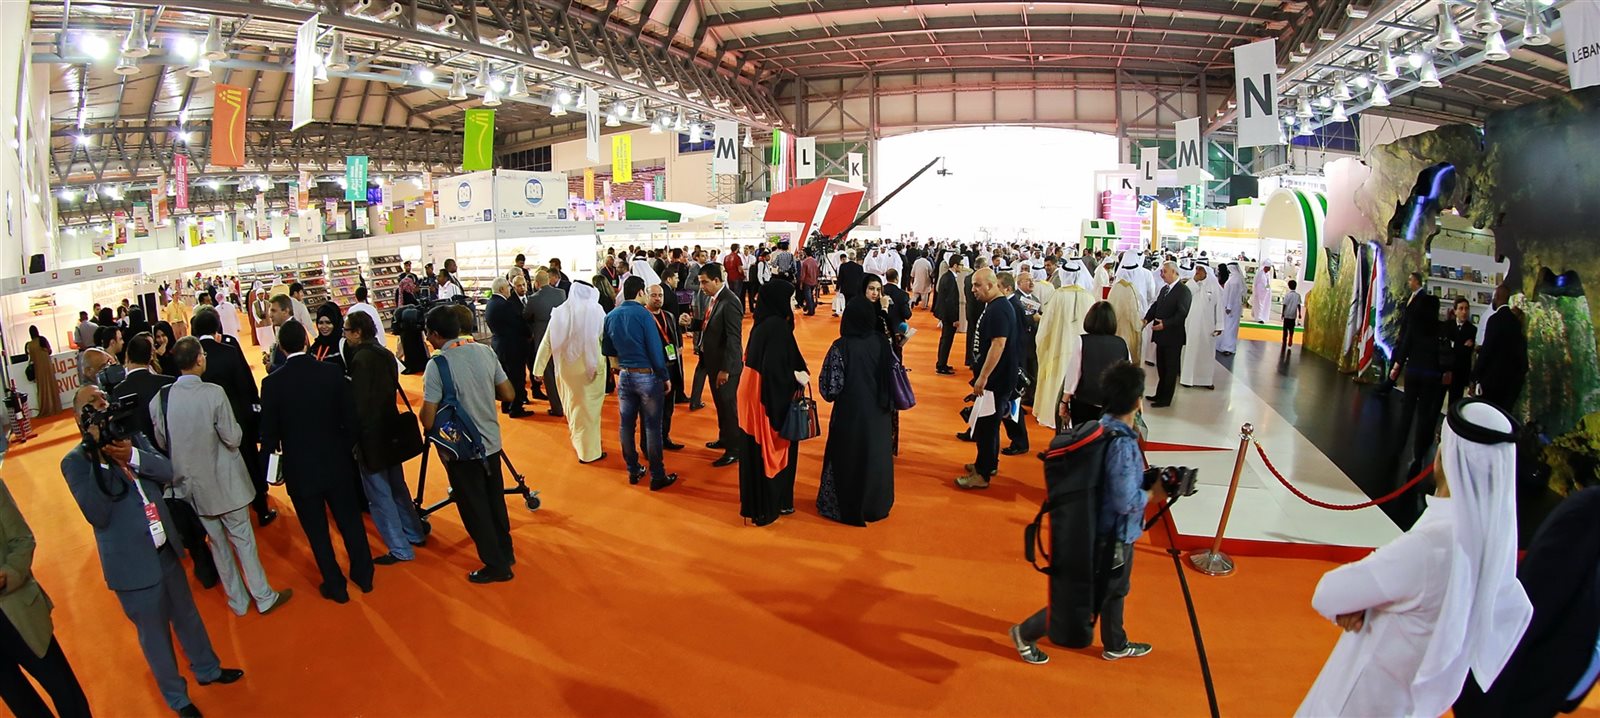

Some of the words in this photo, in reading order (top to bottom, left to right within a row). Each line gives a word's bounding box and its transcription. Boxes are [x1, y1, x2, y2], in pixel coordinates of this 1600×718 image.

[1243, 73, 1272, 118] N
[587, 110, 598, 144] N
[716, 137, 736, 160] M
[802, 148, 810, 165] L
[1179, 139, 1199, 167] M
[851, 162, 860, 176] K
[1146, 161, 1153, 180] L
[56, 374, 80, 393] RVIC
